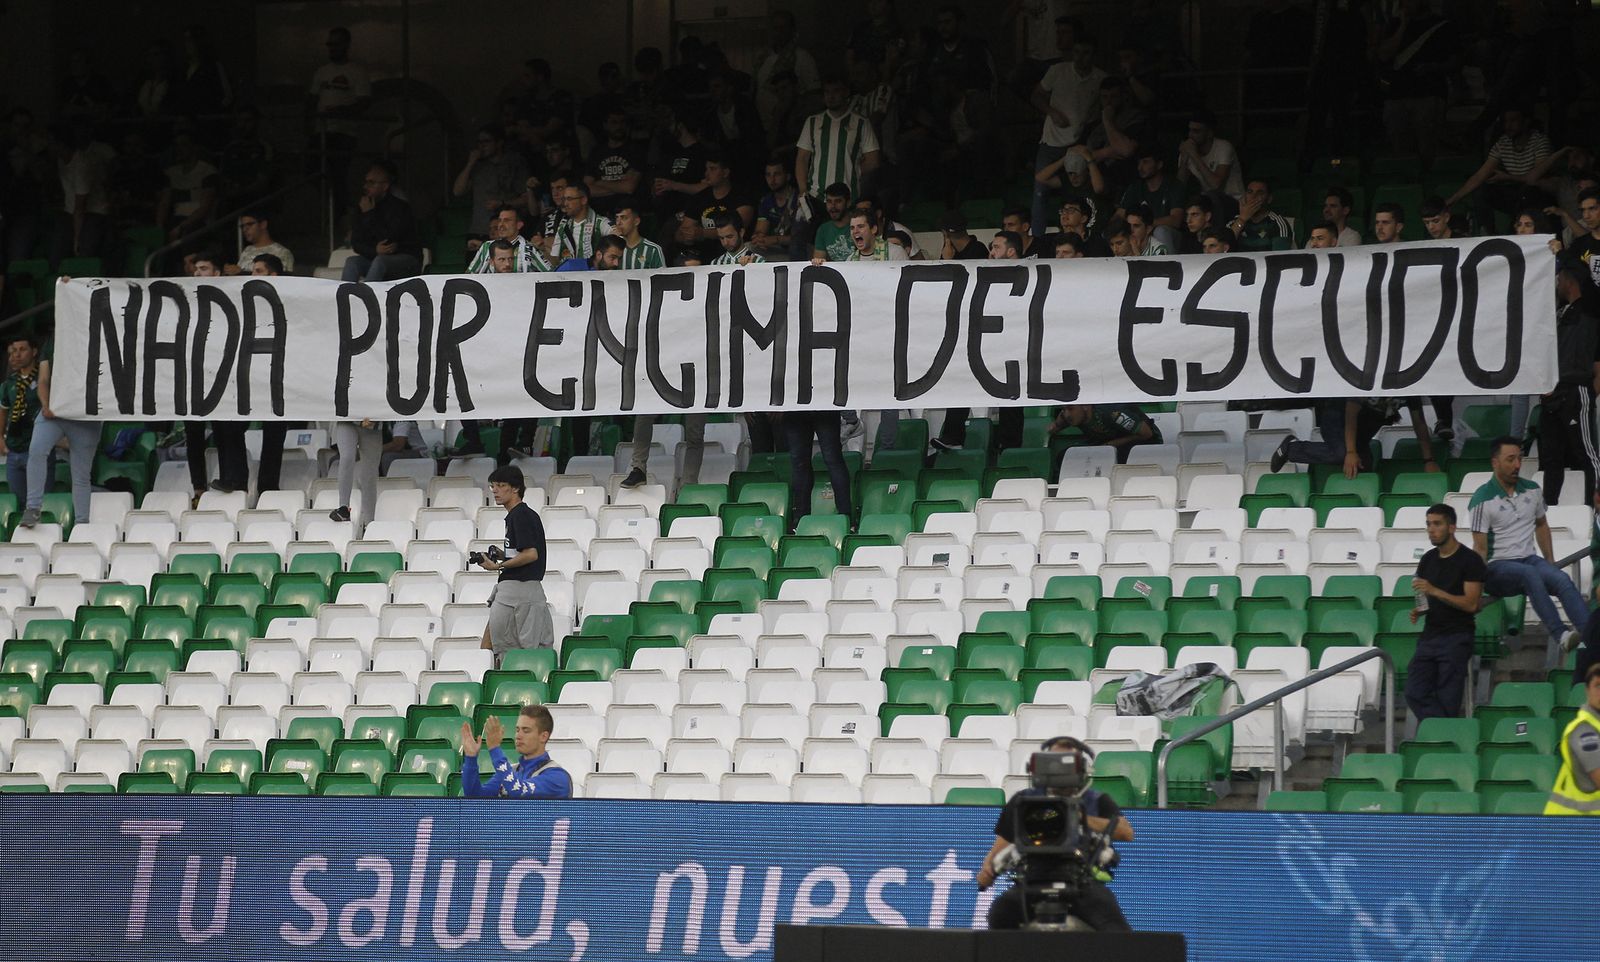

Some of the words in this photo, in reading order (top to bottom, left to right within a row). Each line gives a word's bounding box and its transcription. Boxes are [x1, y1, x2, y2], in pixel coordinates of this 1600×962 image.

[86, 279, 287, 416] NADA
[334, 278, 491, 416] POR
[523, 265, 852, 411] ENCIMA
[893, 264, 1081, 402] DEL
[1118, 238, 1526, 397] ESCUDO
[120, 820, 236, 943] Tu
[279, 816, 590, 962] salud,
